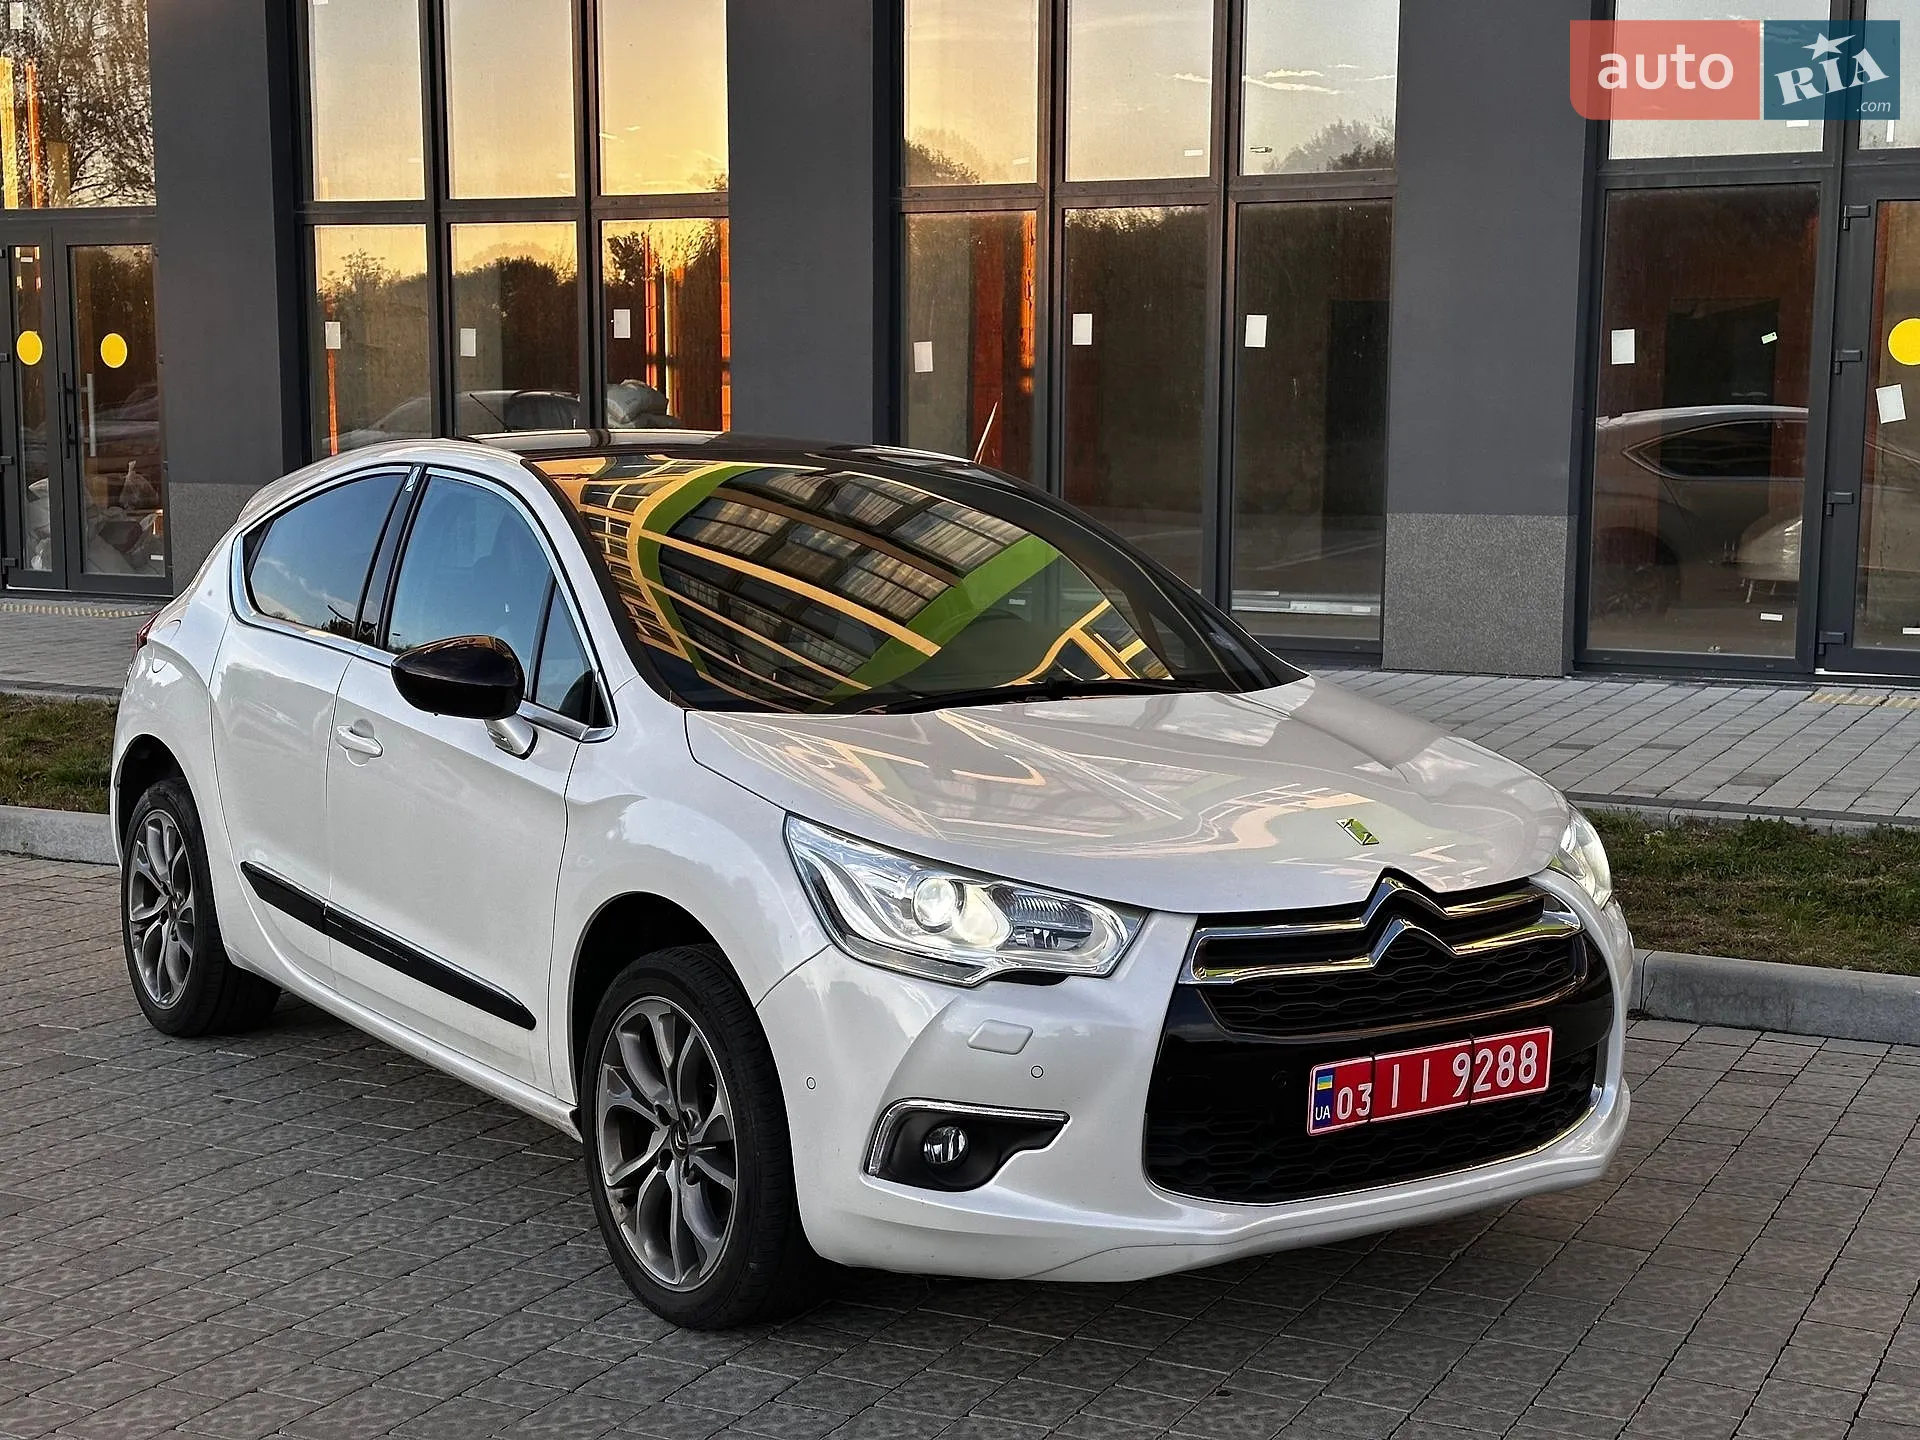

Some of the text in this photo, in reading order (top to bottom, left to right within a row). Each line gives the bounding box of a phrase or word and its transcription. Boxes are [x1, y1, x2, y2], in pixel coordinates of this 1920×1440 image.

[1337, 1083, 1372, 1120] 03
[1453, 1041, 1538, 1097] 9288
[1315, 1105, 1331, 1121] UA
